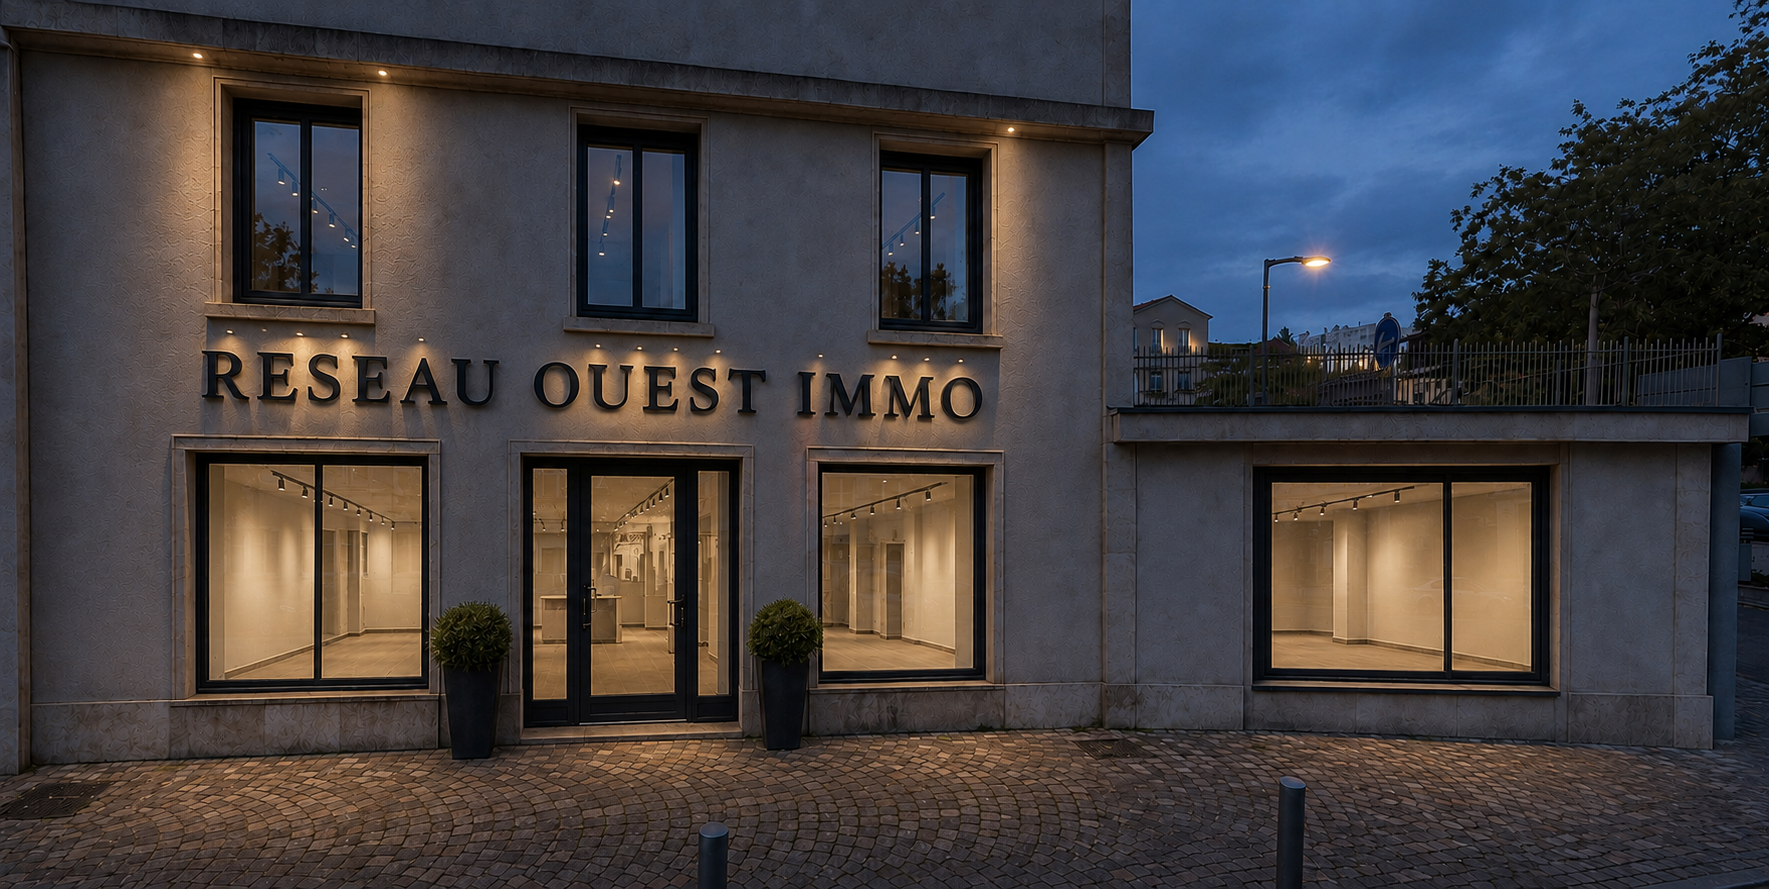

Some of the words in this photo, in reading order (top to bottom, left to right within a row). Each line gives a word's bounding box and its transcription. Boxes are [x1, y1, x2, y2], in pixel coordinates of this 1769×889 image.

[201, 350, 499, 406] RESEAU
[534, 361, 767, 414] OUEST
[797, 371, 983, 421] IMMO
